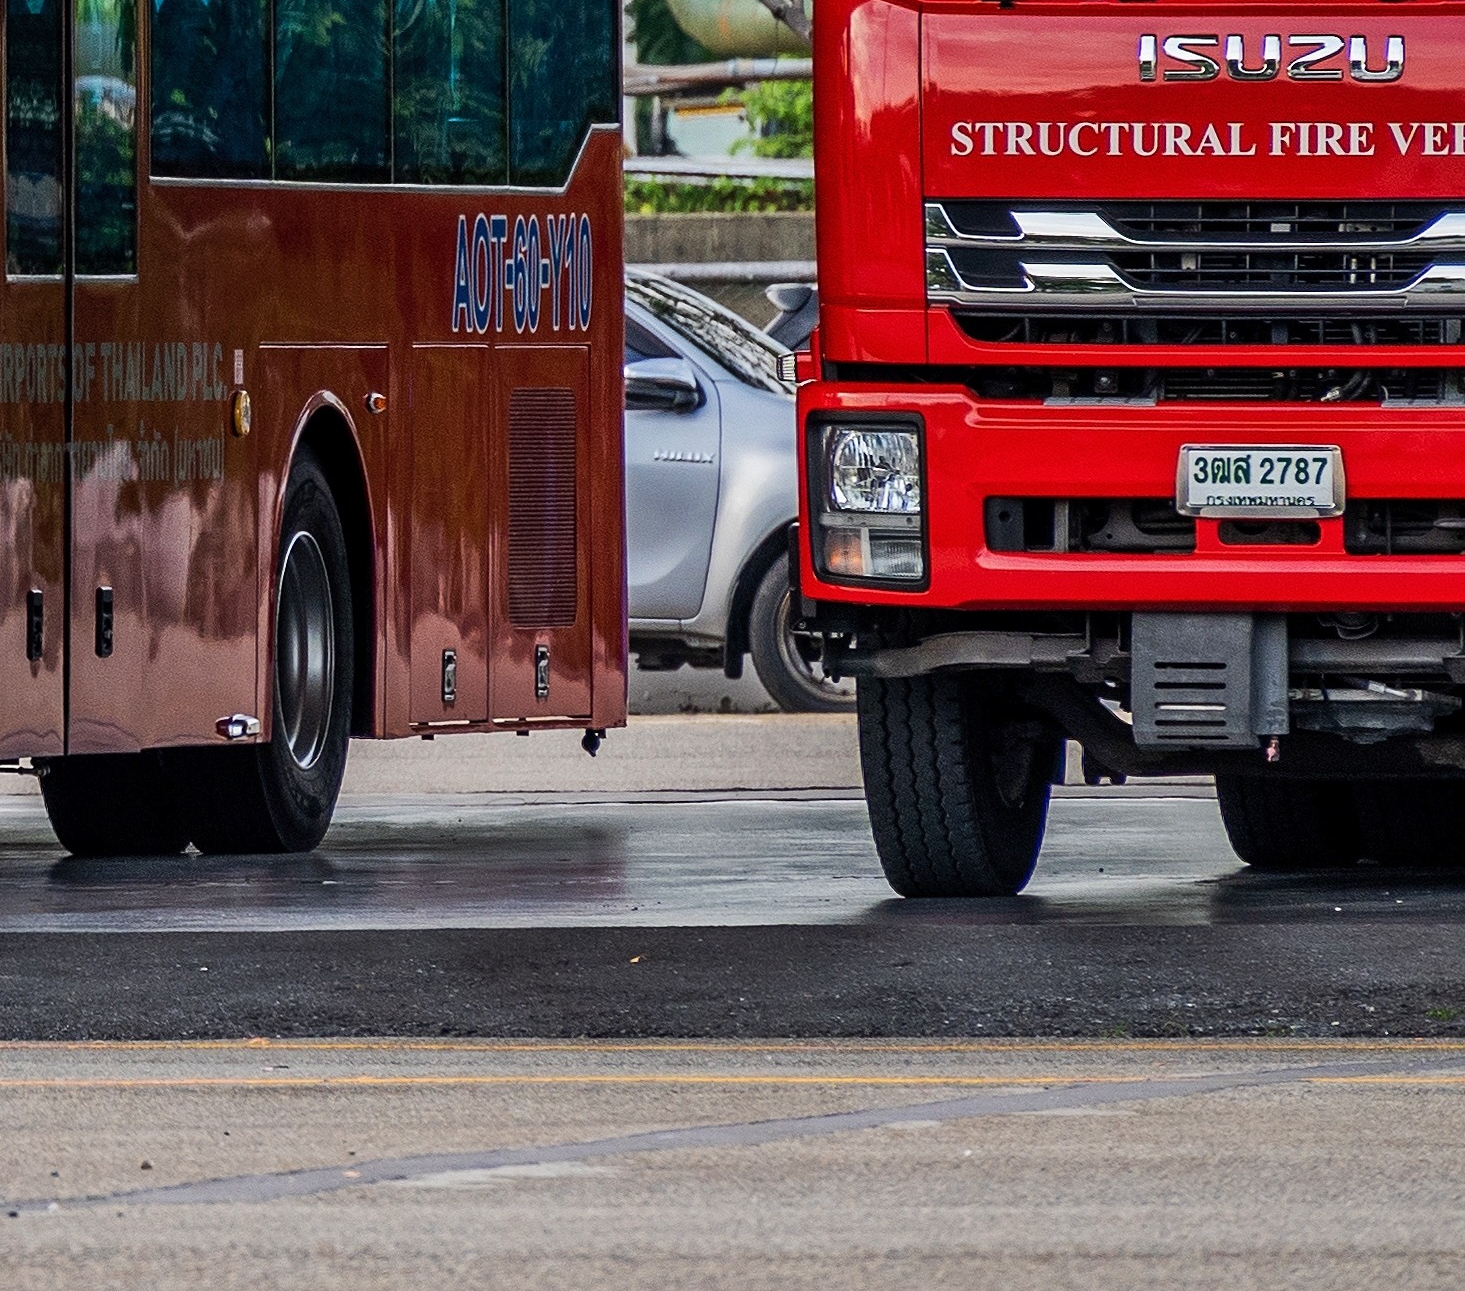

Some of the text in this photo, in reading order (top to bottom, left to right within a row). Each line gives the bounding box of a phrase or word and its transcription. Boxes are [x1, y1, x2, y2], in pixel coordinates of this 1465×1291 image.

[1137, 34, 1406, 84] ISUZU
[950, 121, 1258, 157] STRUCTURAL
[1267, 121, 1376, 157] FIRE
[451, 212, 593, 336] AOT-60-Y10
[72, 341, 96, 402] OF
[100, 341, 188, 402] THAILAND
[1259, 456, 1329, 485] 2787
[1206, 494, 1316, 507] กรงเทพมหานคร
